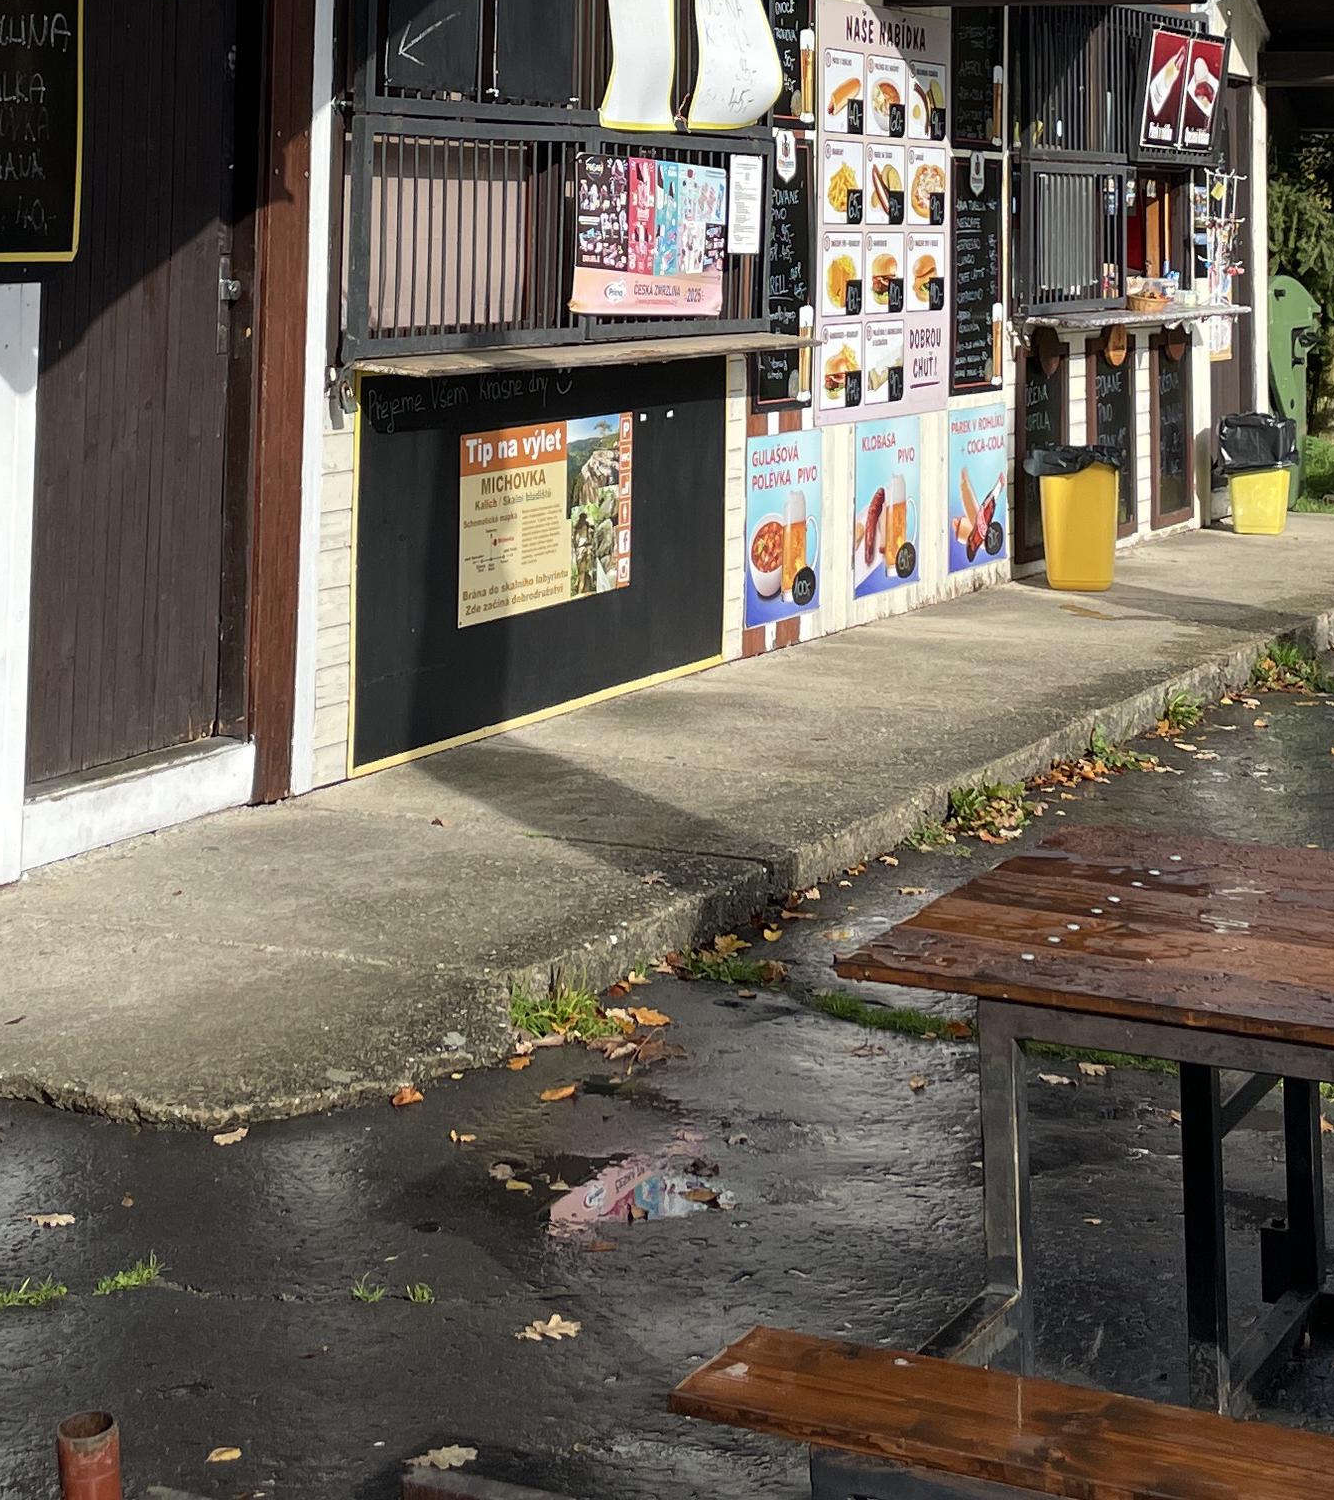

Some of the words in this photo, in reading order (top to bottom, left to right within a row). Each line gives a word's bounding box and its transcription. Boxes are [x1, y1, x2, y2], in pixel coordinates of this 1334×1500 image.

[846, 11, 874, 44] NAŠE
[879, 19, 926, 51] NABÍDKA
[910, 328, 941, 350] DOBROU
[466, 438, 493, 467] Tip
[497, 438, 518, 459] na
[522, 427, 562, 461] výlet
[861, 432, 896, 452] KLOBÁSA
[967, 435, 1004, 455] COCA-COLA
[752, 440, 799, 467] GULÁŠOVÁ
[897, 446, 915, 464] PIVO
[480, 468, 546, 495] MICHOVKA
[752, 467, 791, 491] POLÉVKA
[797, 465, 818, 484] PIVO
[488, 583, 499, 597] do
[466, 602, 482, 615] Zde
